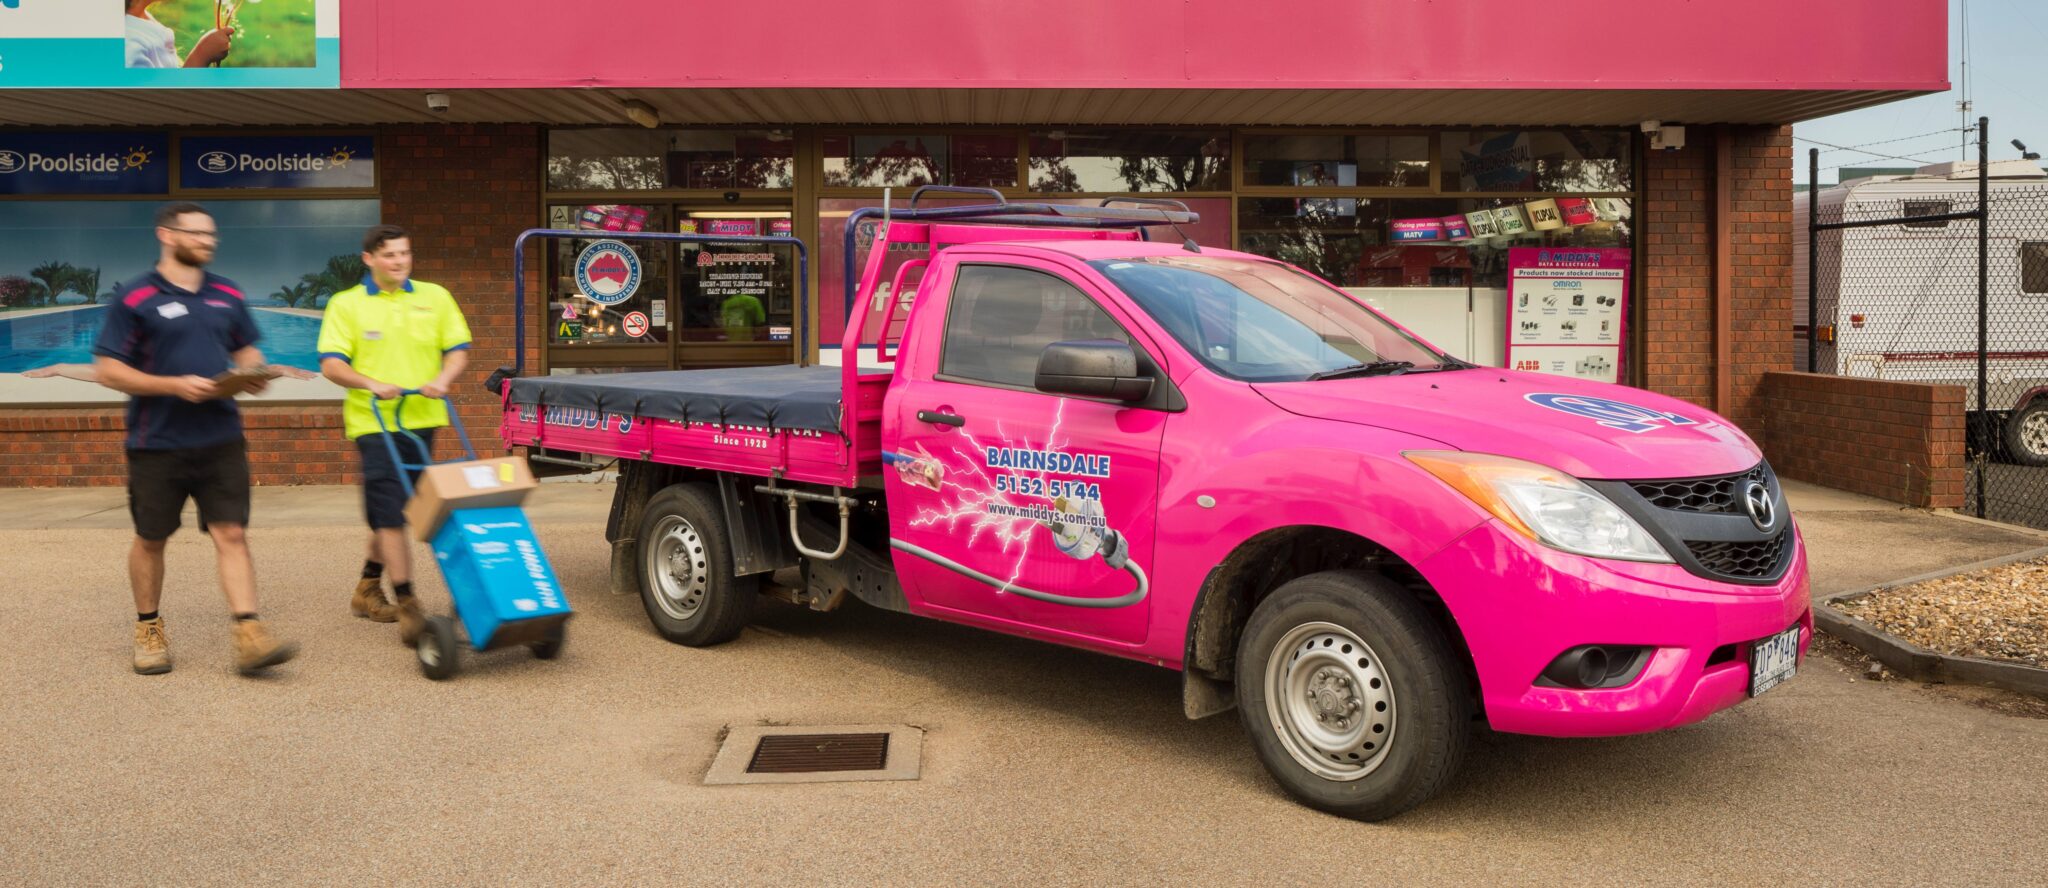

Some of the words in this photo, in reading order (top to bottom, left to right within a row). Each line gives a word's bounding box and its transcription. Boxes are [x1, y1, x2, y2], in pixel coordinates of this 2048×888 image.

[28, 153, 119, 172] Poolside
[239, 153, 324, 171] Poolside
[1403, 231, 1423, 239] MATV
[597, 243, 635, 264] AUSTRALIAN
[1553, 253, 1600, 262] MIDDY'S
[579, 273, 594, 299] OWNED
[602, 273, 637, 301] INDEPENDENT
[1516, 360, 1540, 371] ABB
[713, 435, 739, 446] Since
[744, 438, 767, 449] 1928
[987, 447, 1109, 477] BAIRNSDALE
[996, 475, 1043, 496] 5152
[1050, 479, 1100, 501] 5144
[988, 503, 1107, 528] www.middys.com.au
